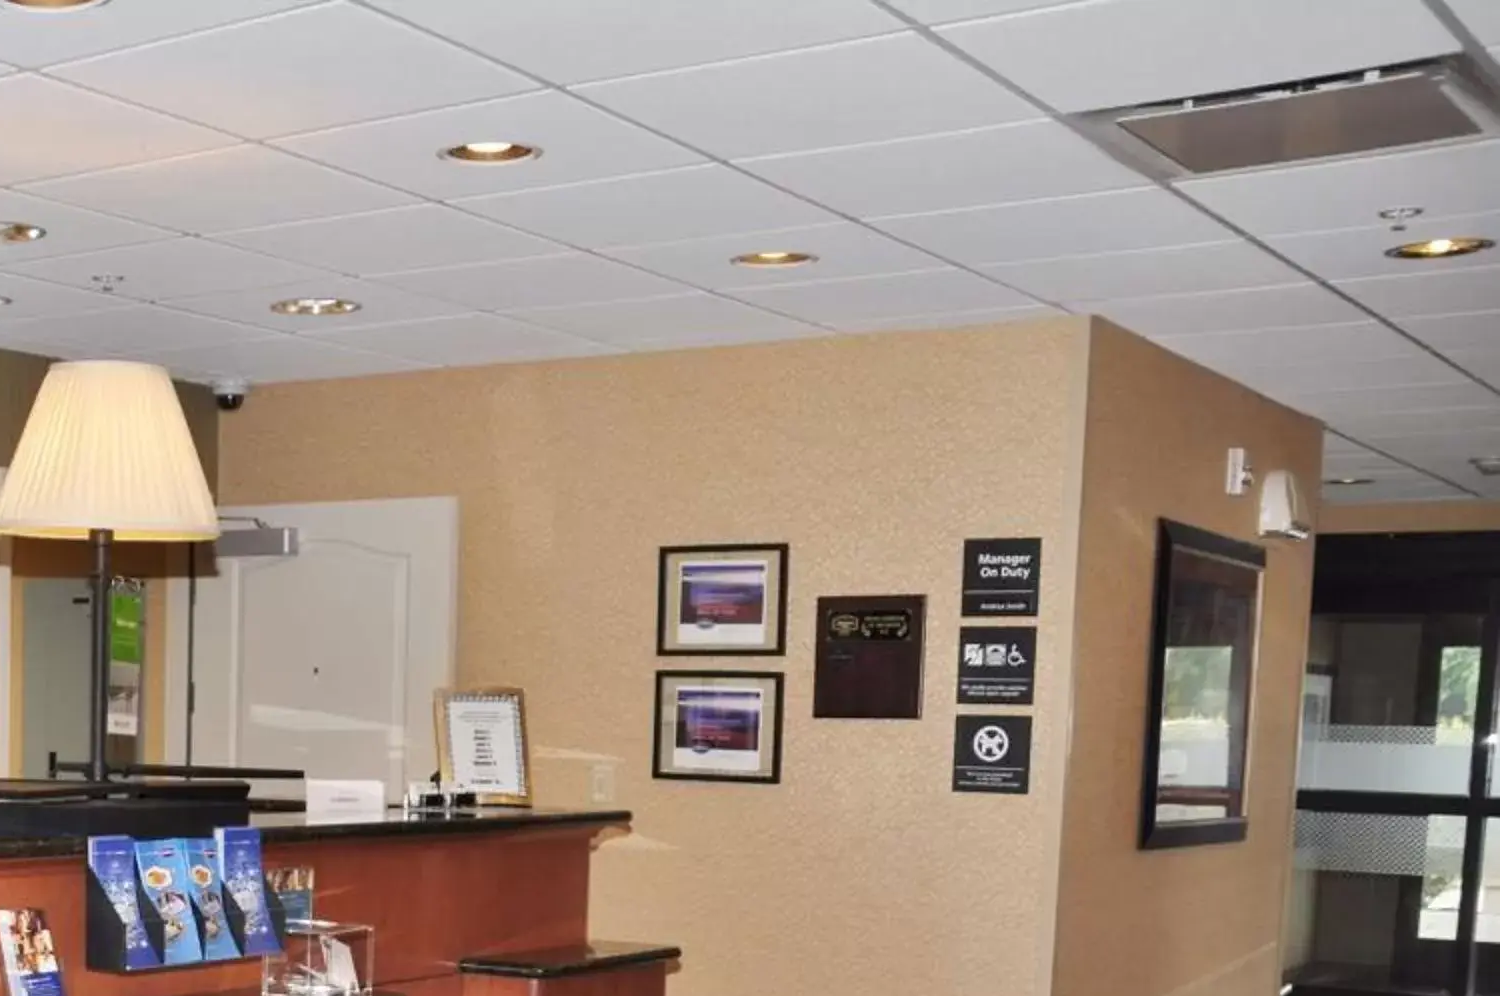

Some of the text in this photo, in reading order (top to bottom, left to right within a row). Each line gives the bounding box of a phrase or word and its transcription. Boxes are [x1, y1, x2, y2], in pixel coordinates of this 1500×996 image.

[978, 554, 1031, 567] Manager
[980, 567, 1031, 580] On Duty
